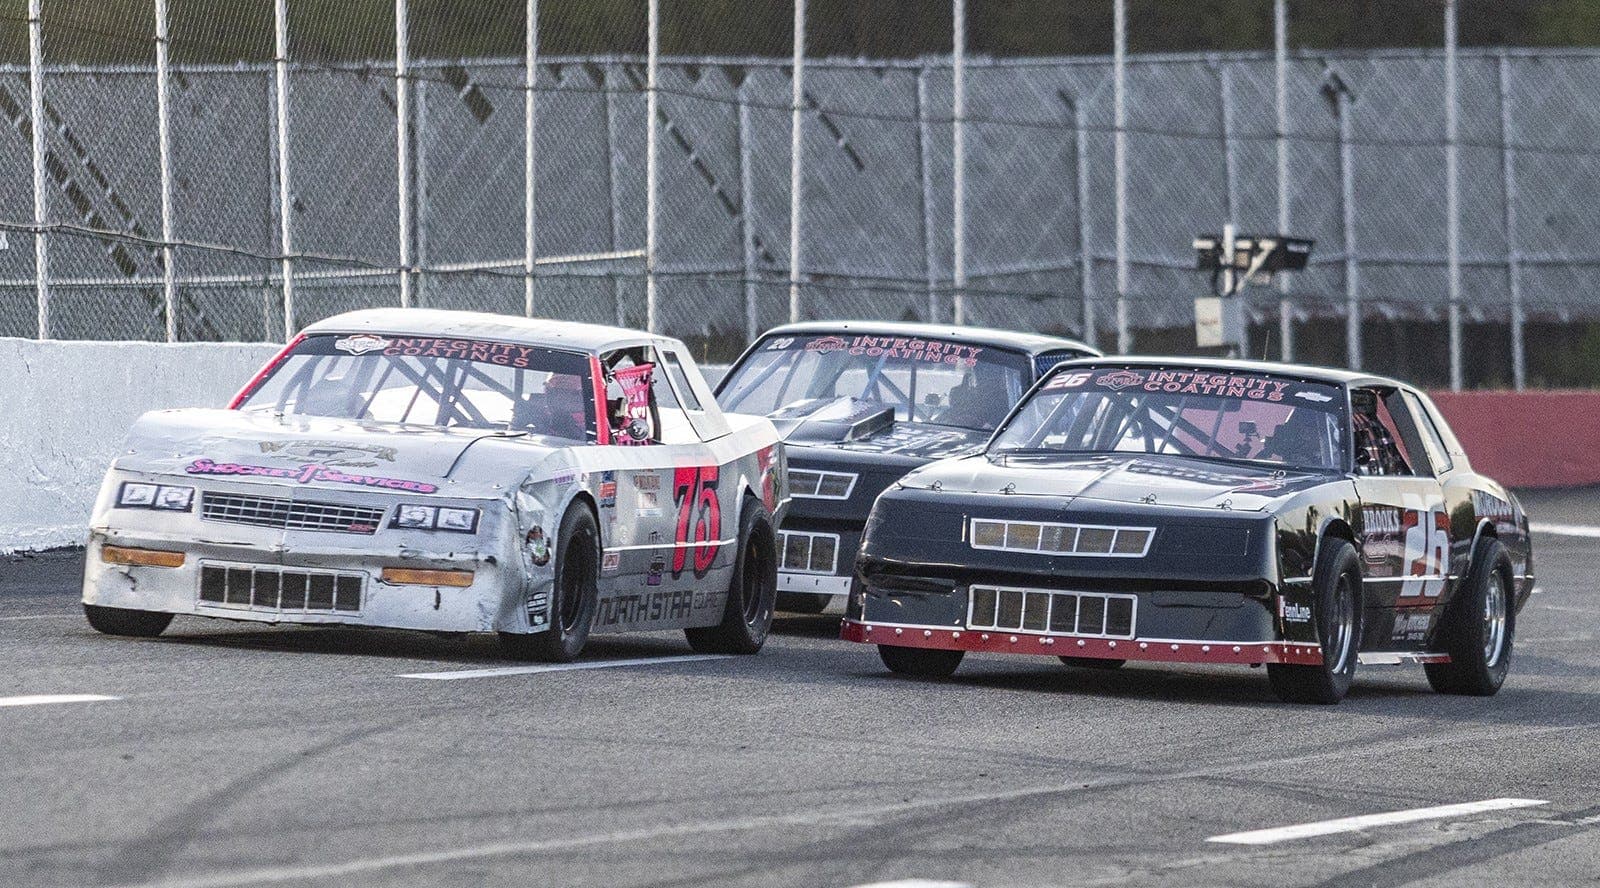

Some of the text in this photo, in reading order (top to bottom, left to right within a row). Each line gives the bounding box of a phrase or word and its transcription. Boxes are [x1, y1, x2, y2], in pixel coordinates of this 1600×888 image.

[383, 347, 530, 367] COATINGS
[388, 338, 533, 358] INTEGRITY
[849, 346, 978, 367] COATINGS
[851, 336, 983, 358] INTEGRITY
[1043, 372, 1093, 390] 26
[1143, 381, 1285, 401] COATINGS
[1149, 371, 1290, 392] INTEGRITY
[672, 458, 721, 580] 75
[1362, 508, 1400, 534] BROOKS
